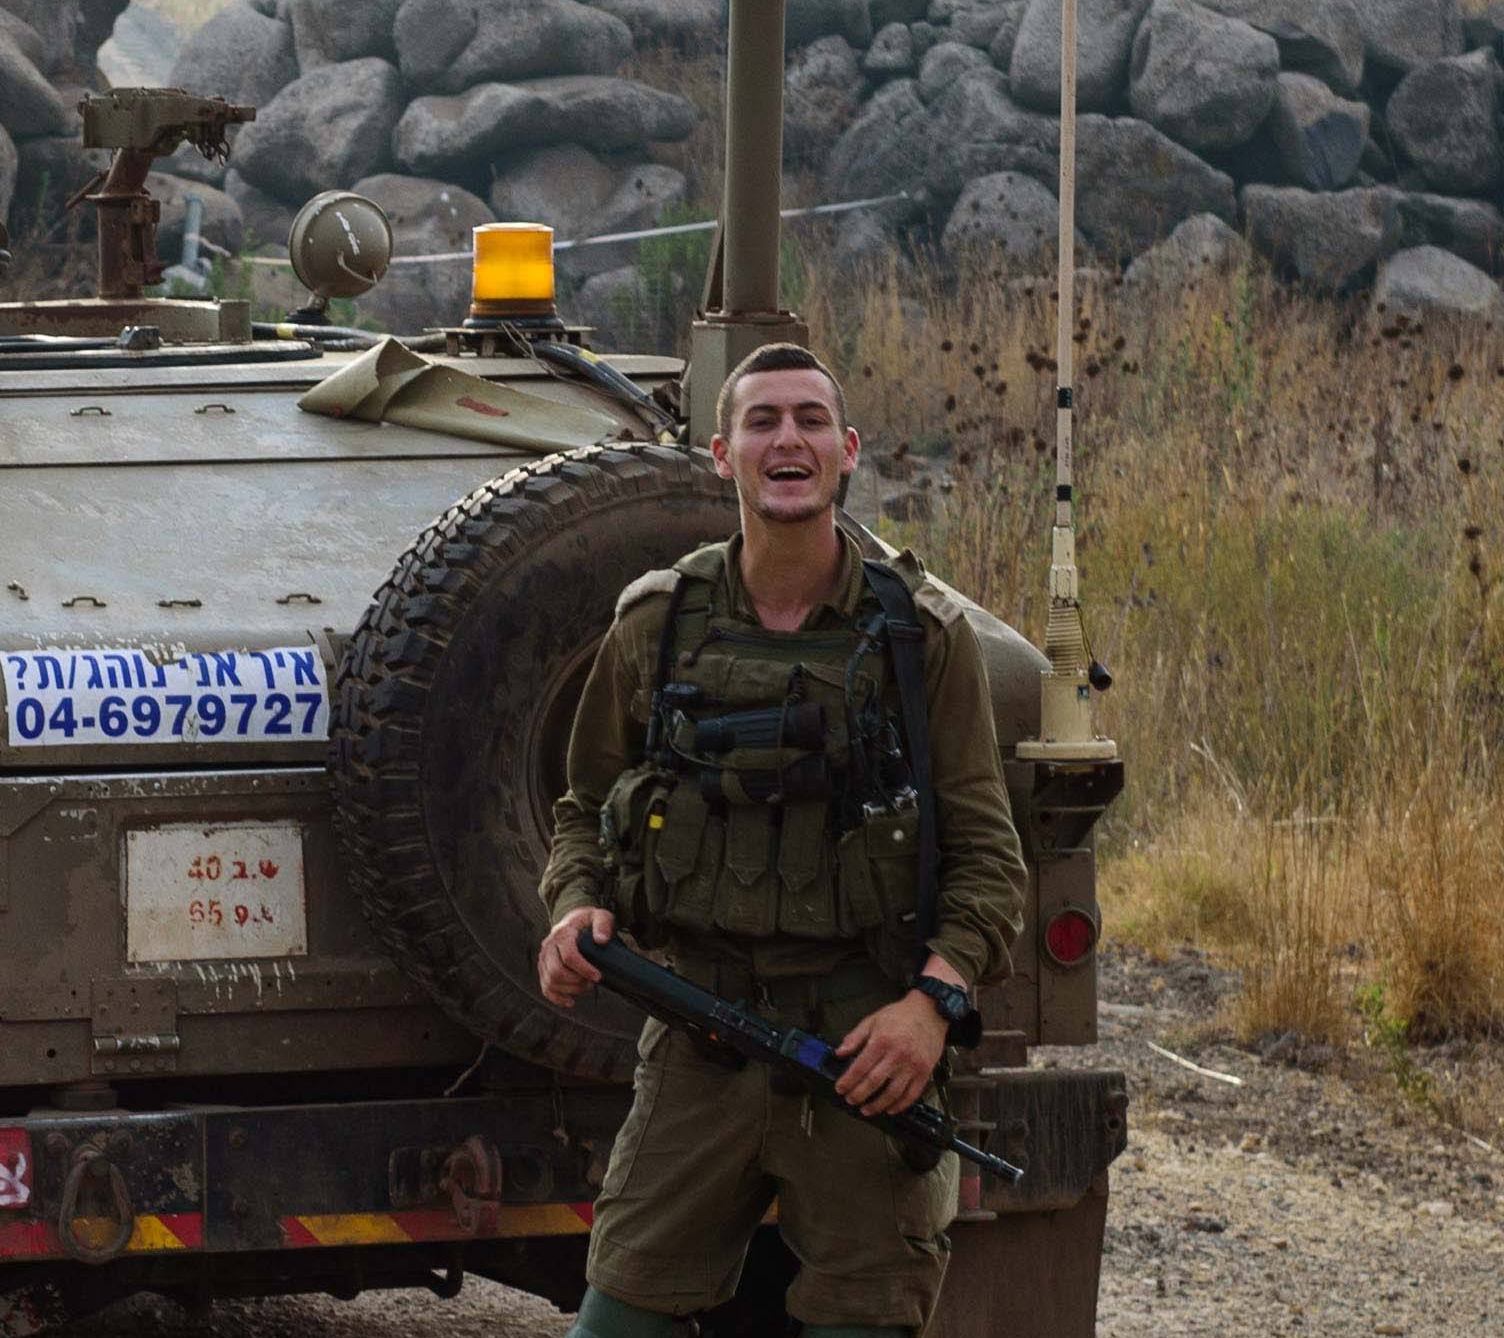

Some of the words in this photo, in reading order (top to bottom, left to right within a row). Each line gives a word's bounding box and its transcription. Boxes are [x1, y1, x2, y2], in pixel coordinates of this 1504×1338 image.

[178, 651, 243, 686] אני
[249, 650, 321, 689] איך
[15, 692, 323, 740] 04-6979727
